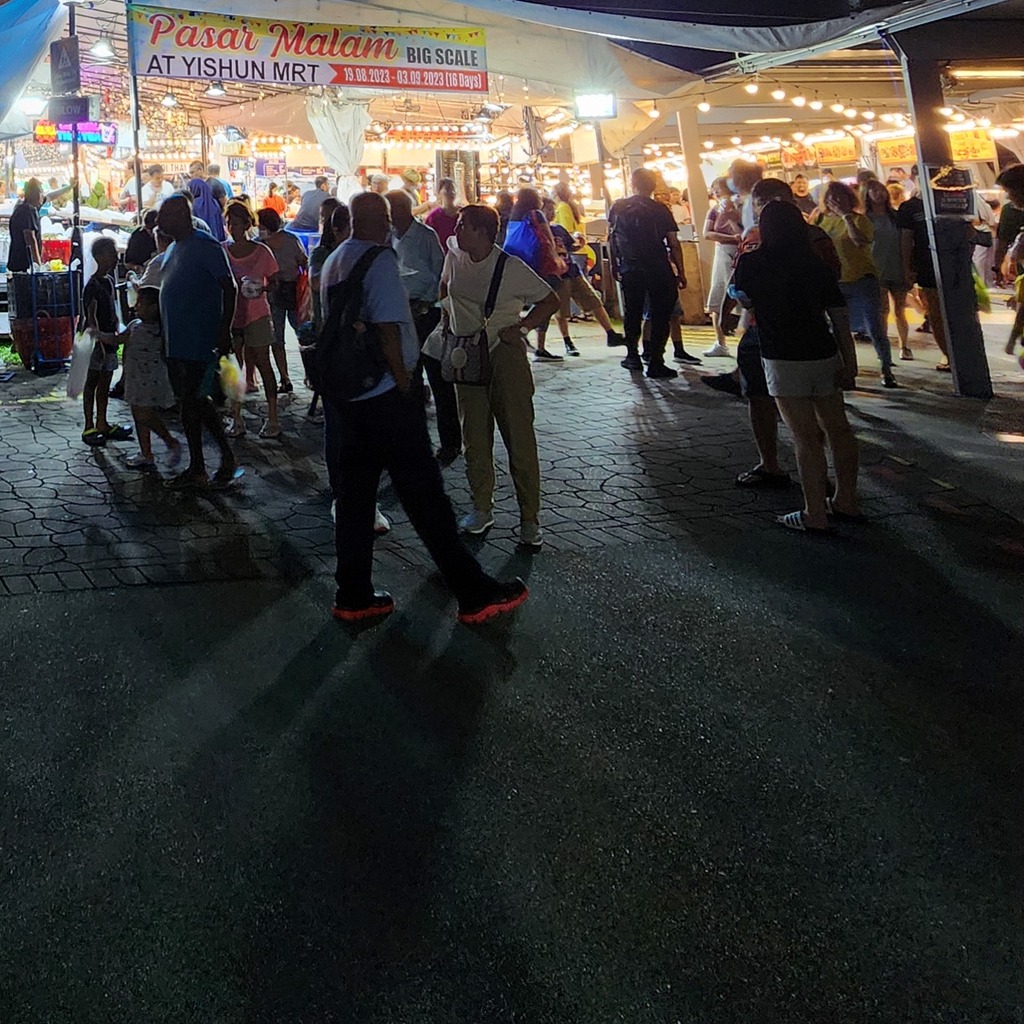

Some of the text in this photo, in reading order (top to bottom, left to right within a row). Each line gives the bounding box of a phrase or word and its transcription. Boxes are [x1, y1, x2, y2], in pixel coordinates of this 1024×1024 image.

[147, 13, 399, 61] Pasar Malam
[146, 54, 320, 83] AT YISHUN MRT
[406, 46, 479, 67] BIG SCALE
[343, 67, 391, 84] 19.08.2023
[396, 69, 444, 87] 03.09.2023
[445, 72, 458, 88] (16
[459, 73, 482, 90] Days)
